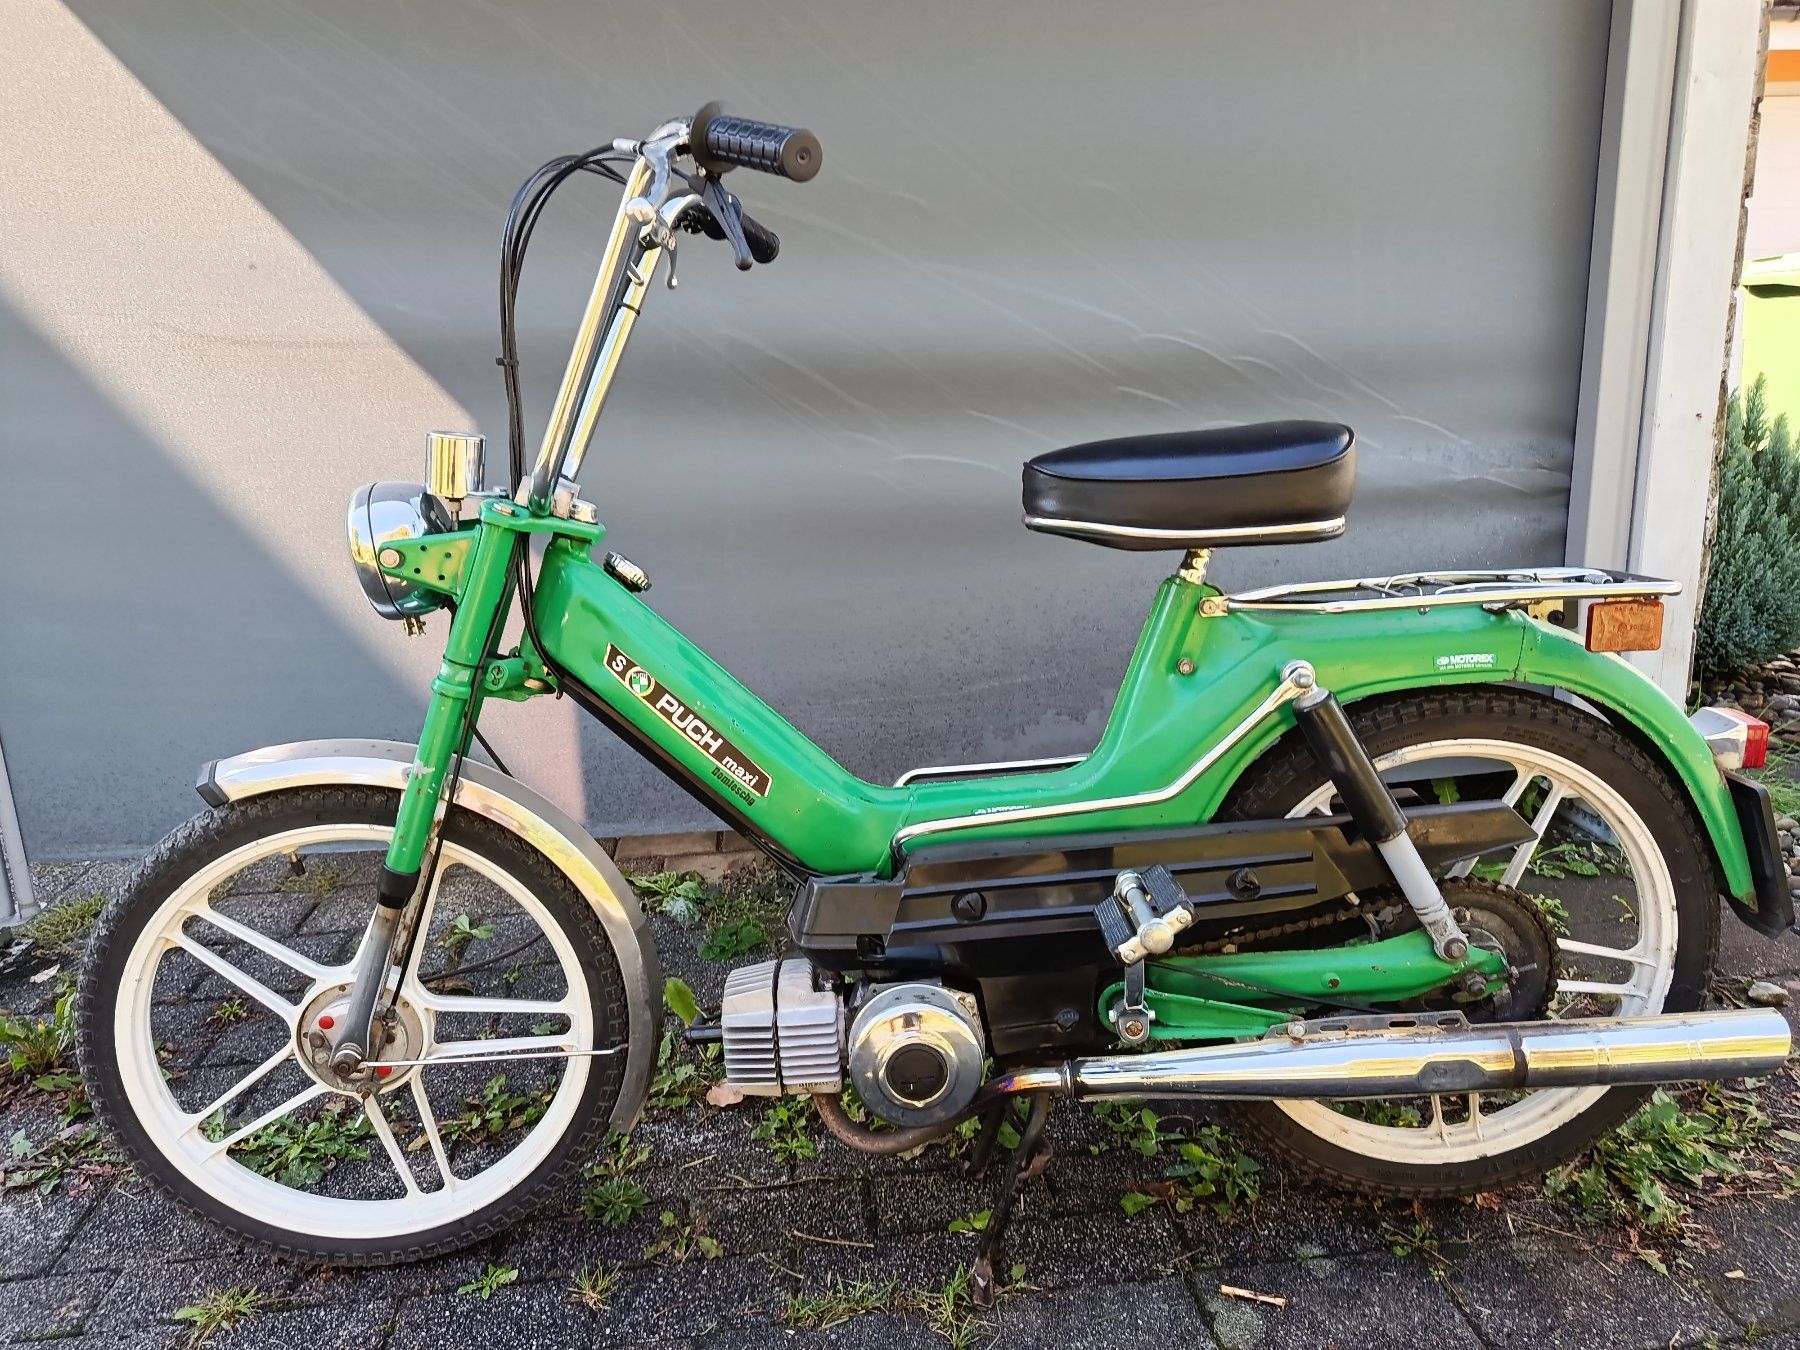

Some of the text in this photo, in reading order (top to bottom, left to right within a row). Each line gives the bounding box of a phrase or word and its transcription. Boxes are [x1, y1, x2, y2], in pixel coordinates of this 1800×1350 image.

[1450, 653, 1494, 665] MOTOREX
[611, 655, 759, 787] S PUCH maxi
